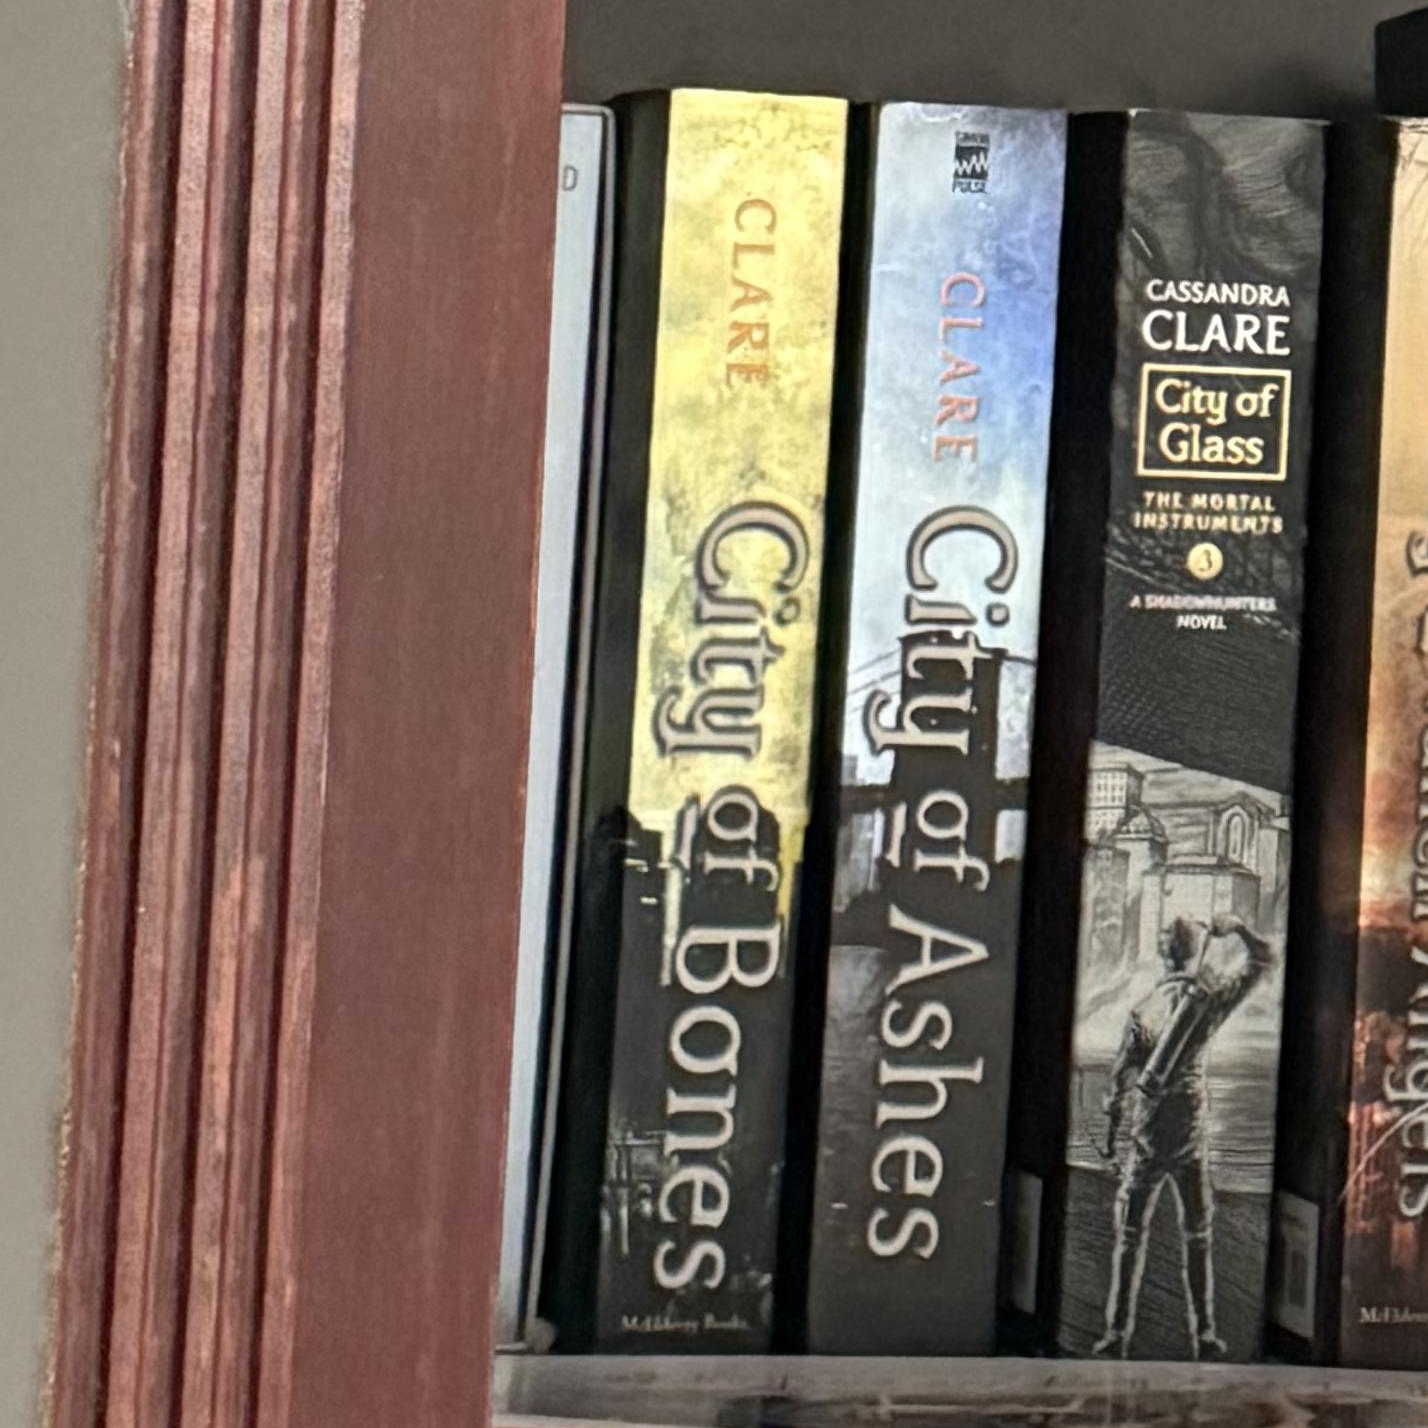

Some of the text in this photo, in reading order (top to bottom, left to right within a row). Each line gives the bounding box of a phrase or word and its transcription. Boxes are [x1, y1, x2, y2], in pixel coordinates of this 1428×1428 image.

[725, 197, 777, 387] CLARE
[1146, 279, 1290, 307] CASSANDRA
[1142, 310, 1291, 356] CLARE
[931, 273, 986, 464] CLARE
[1155, 378, 1279, 426] City of
[1159, 423, 1263, 464] Glass
[1133, 511, 1284, 534] INSTRUMENTS
[1143, 491, 1275, 512] THE MORTAL
[1177, 614, 1227, 630] NOVEL
[652, 500, 811, 1293] City of Bones
[863, 504, 1020, 1262] City of Ashes
